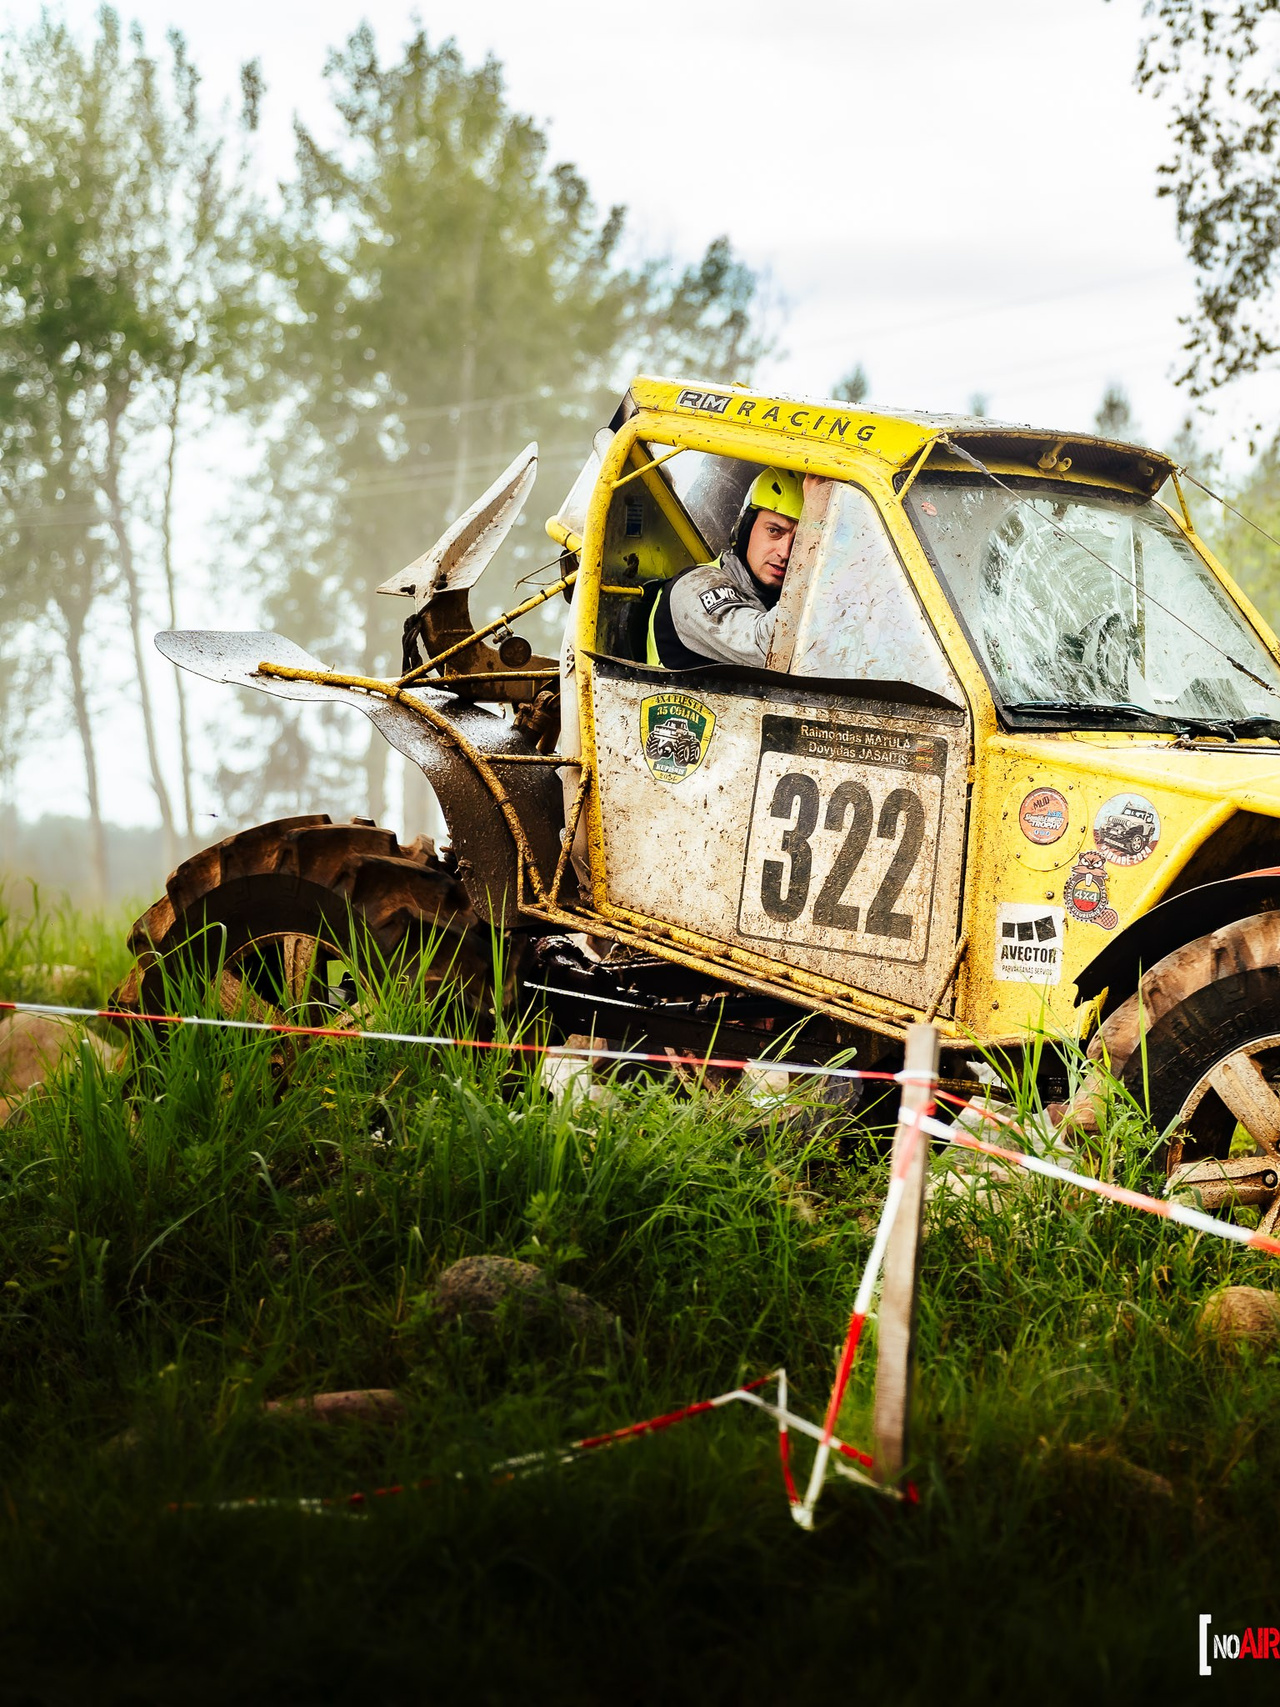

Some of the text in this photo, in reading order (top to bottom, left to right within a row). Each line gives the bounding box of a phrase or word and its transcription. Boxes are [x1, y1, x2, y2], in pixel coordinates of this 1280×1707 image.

[679, 389, 876, 442] RM RACING
[800, 724, 861, 744] Raimondas
[808, 741, 856, 758] Dovydas
[761, 772, 925, 940] 322
[1001, 945, 1057, 963] AVECTOR
